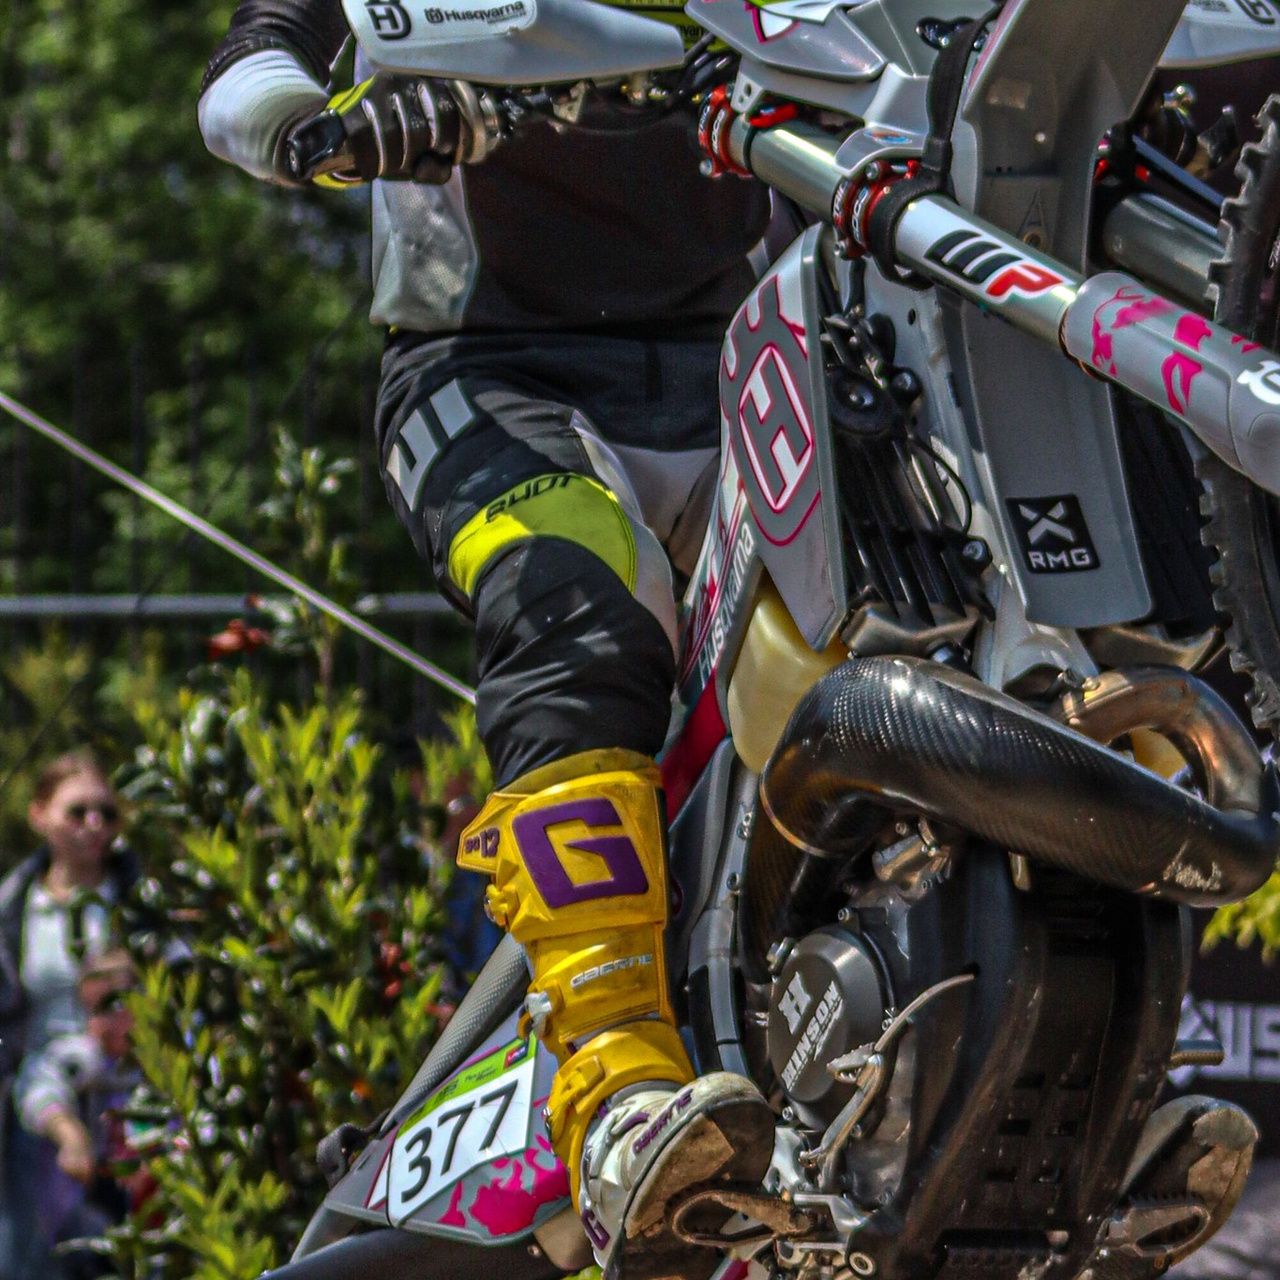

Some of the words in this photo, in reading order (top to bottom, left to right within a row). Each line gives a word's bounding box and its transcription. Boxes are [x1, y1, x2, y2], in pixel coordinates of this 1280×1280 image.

[444, 0, 526, 23] Husqvarna
[1028, 548, 1091, 569] RMG
[781, 980, 841, 1093] HINSON
[401, 1079, 519, 1204] 377
